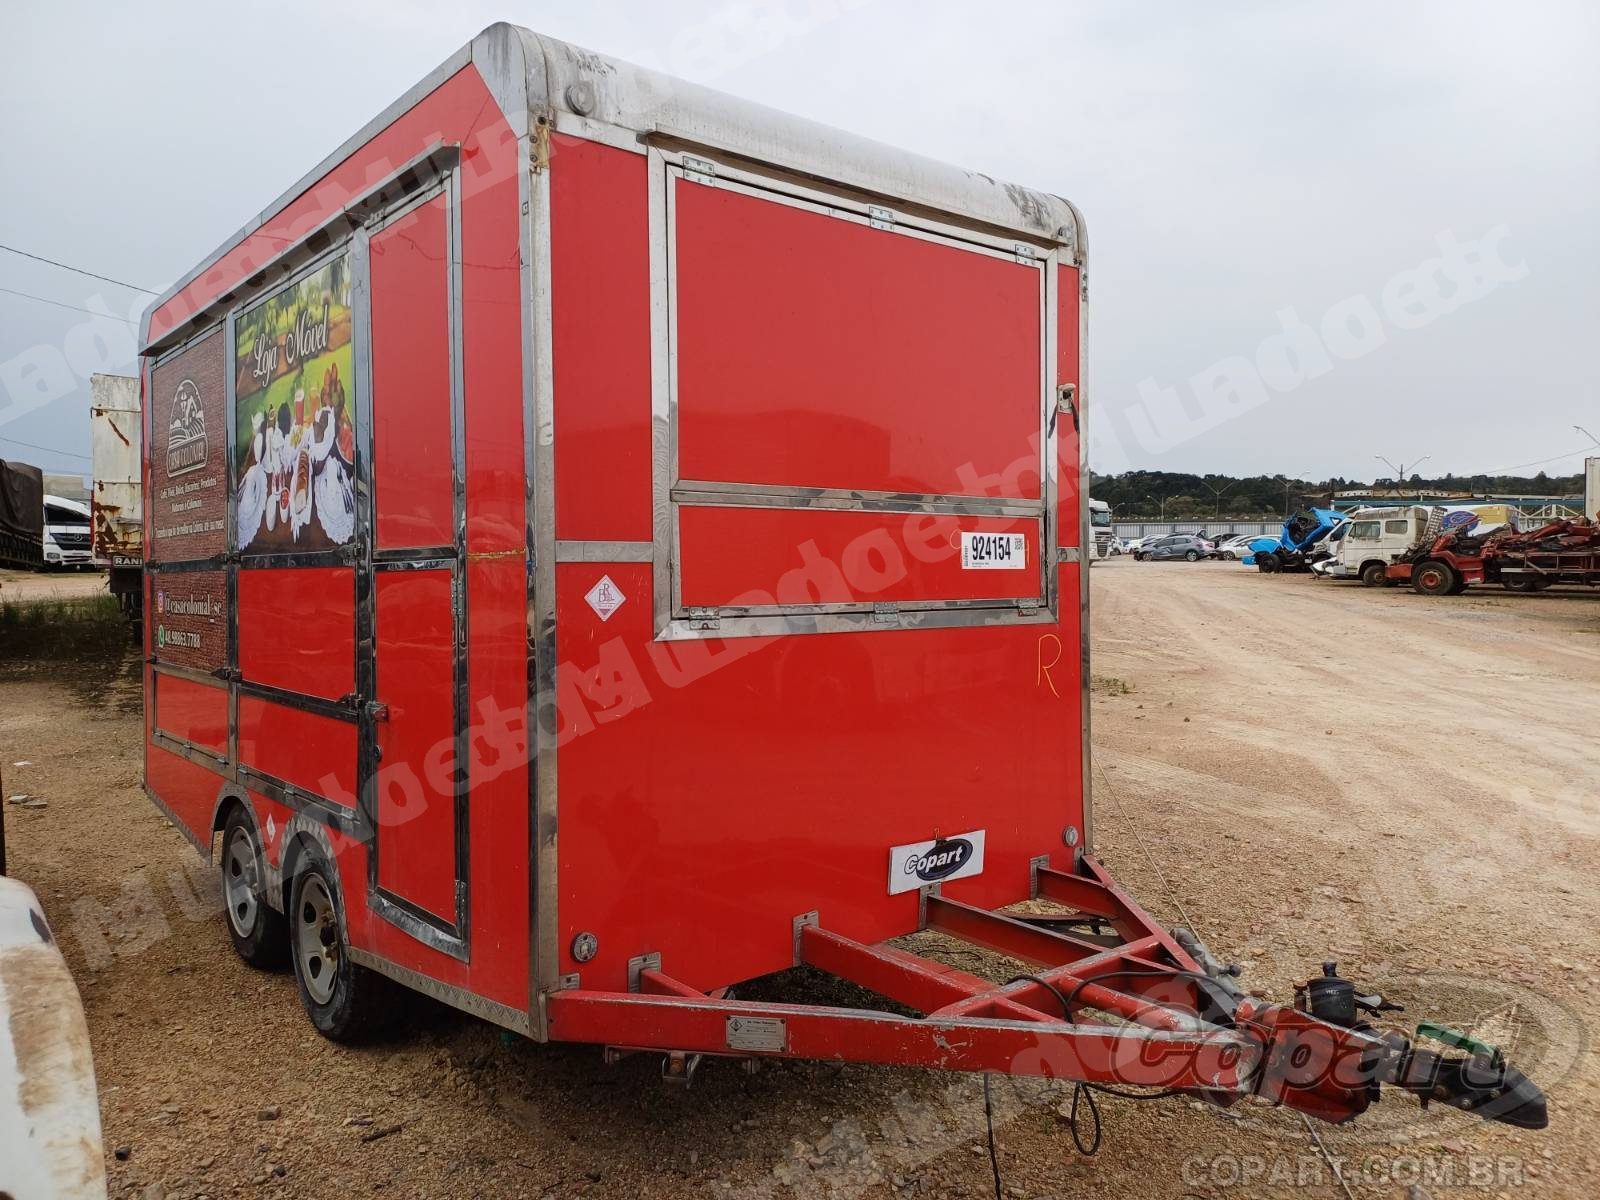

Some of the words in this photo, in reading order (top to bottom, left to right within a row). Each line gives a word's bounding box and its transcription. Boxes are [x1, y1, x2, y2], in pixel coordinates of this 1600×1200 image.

[253, 333, 277, 387] Loja
[286, 304, 328, 364] Móvel
[971, 535, 1012, 561] 924154
[1037, 633, 1062, 698] R
[903, 845, 963, 875] Copart
